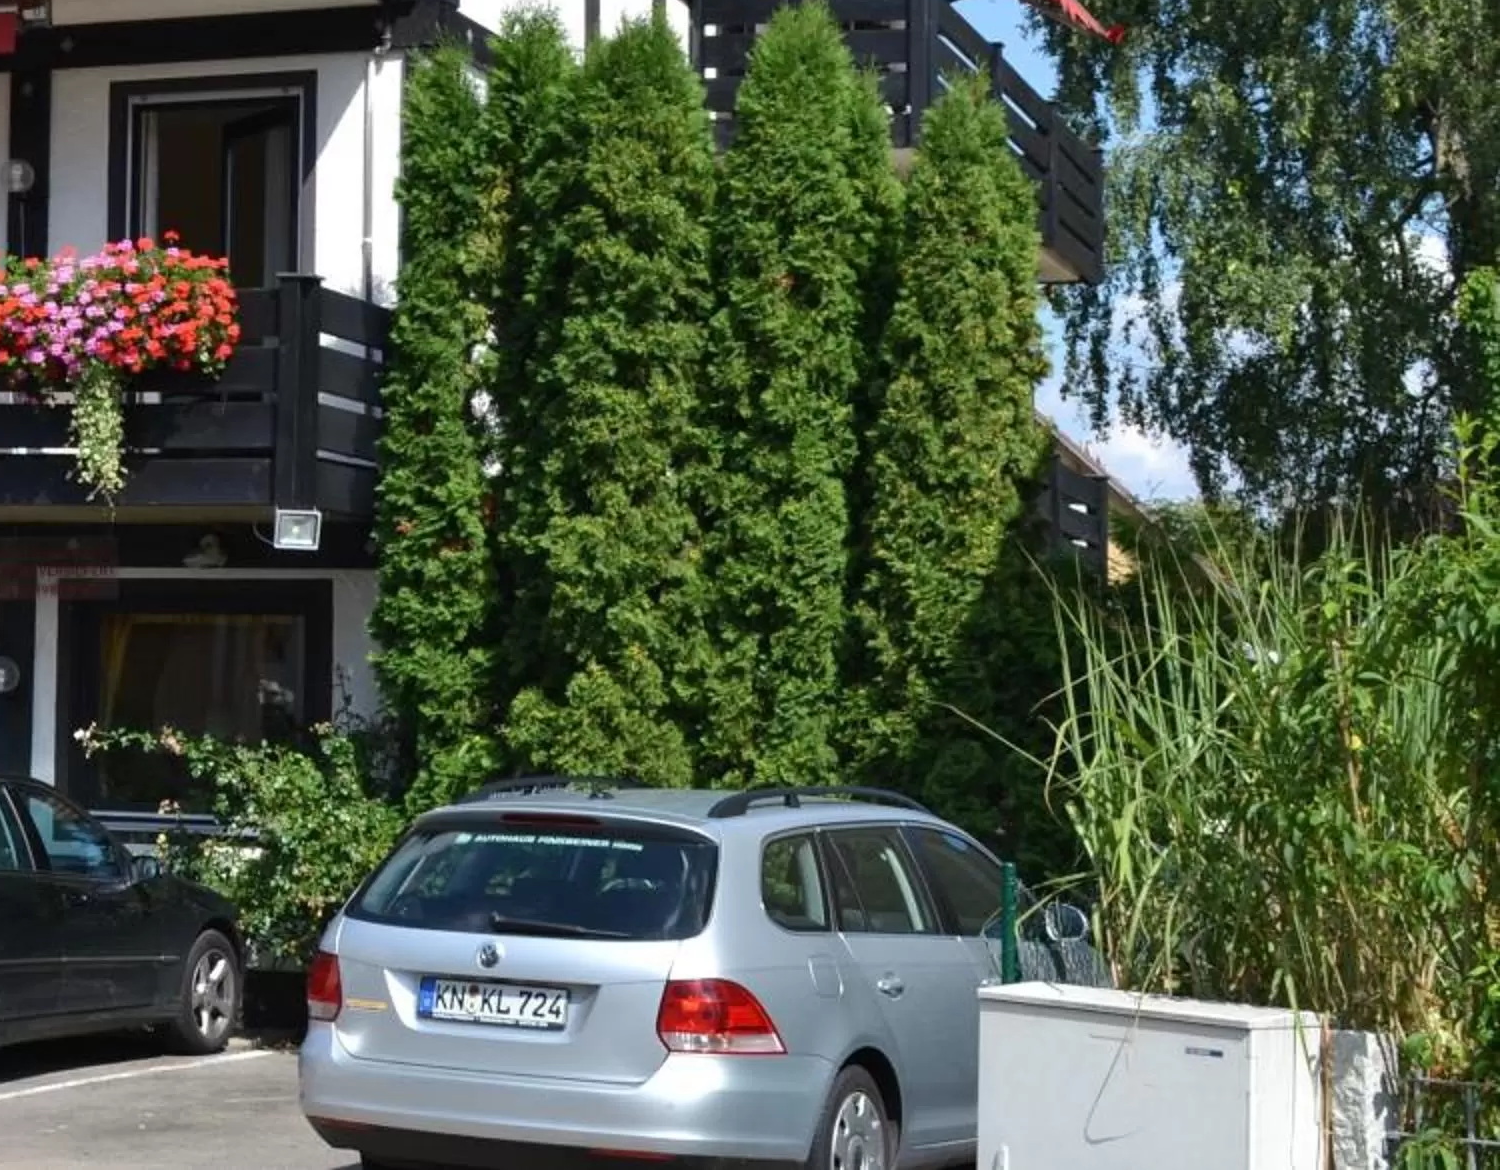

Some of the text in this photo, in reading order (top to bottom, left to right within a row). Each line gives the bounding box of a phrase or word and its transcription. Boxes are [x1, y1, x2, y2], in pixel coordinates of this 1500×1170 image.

[436, 983, 467, 1012] KN
[481, 987, 511, 1015] KL
[518, 990, 562, 1019] 724
